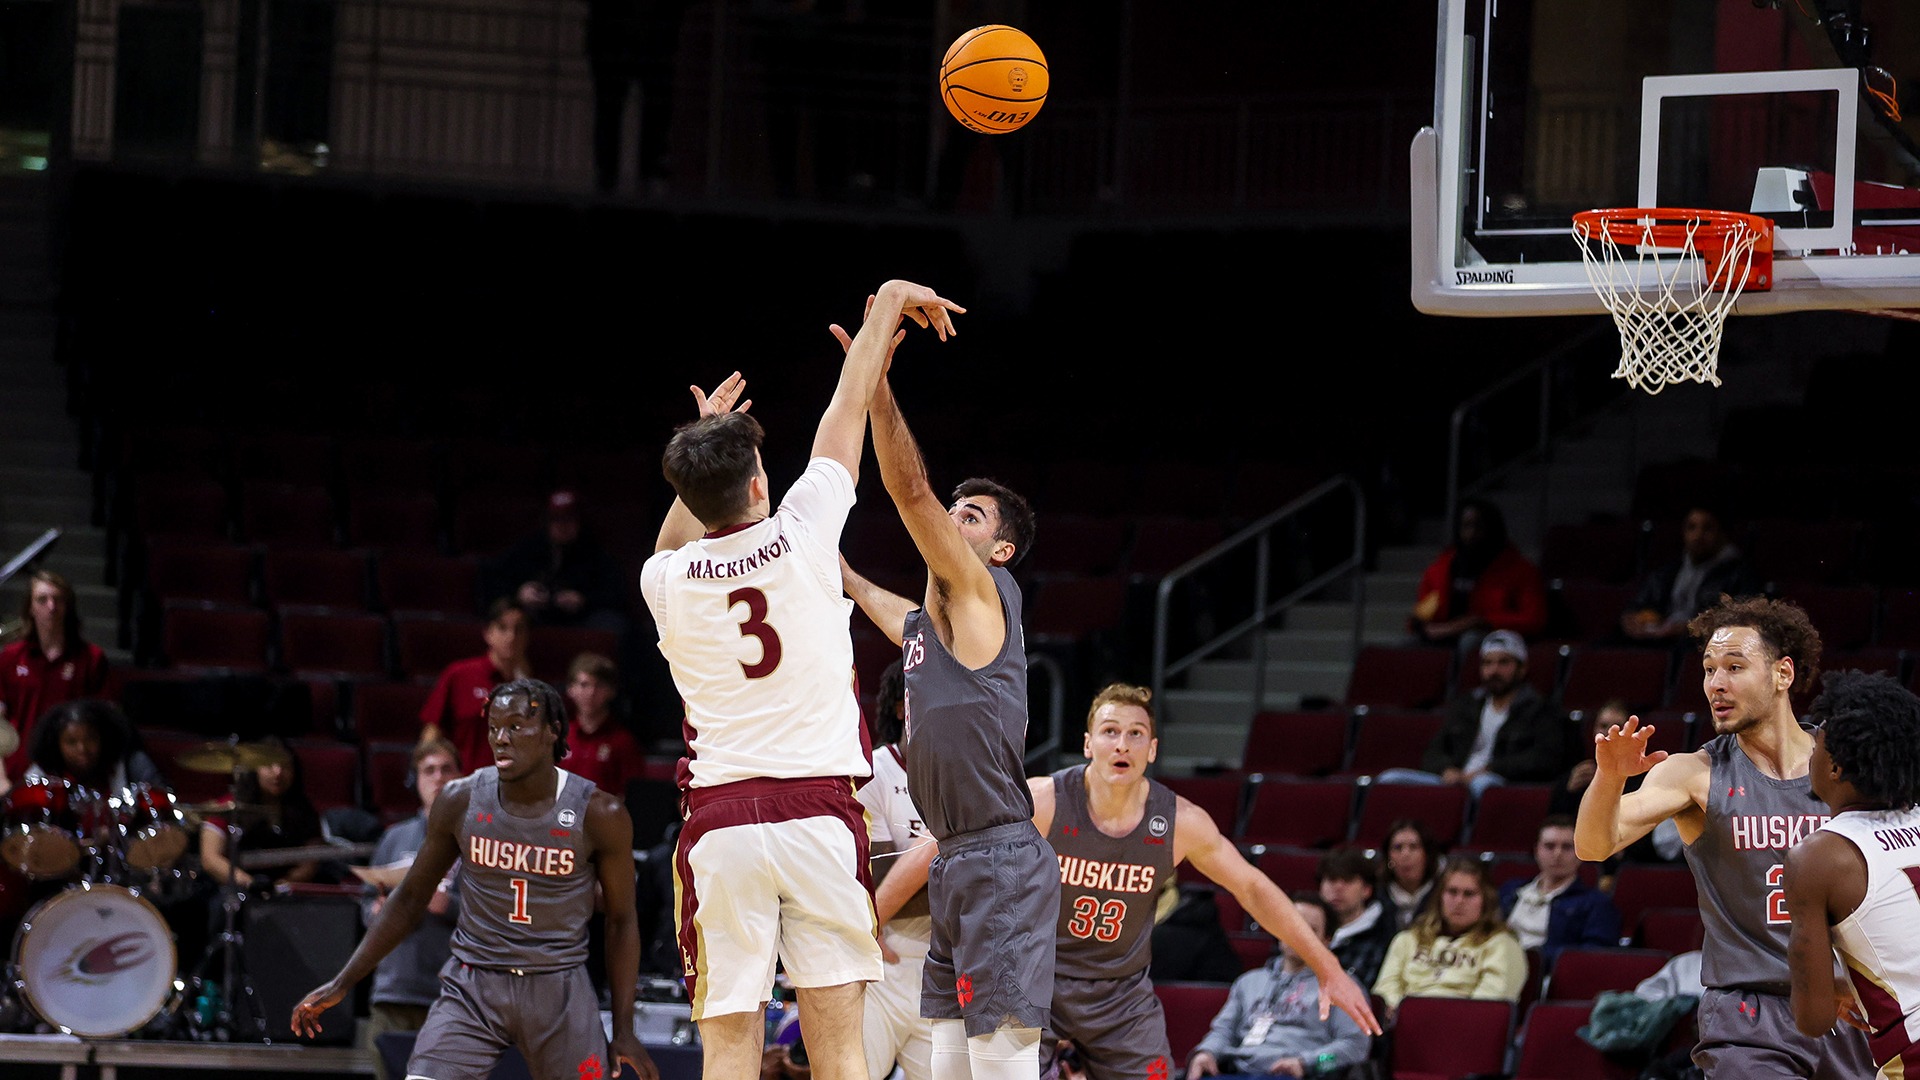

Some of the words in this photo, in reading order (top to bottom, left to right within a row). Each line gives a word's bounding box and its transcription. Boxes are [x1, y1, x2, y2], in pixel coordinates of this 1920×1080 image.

[987, 111, 1030, 123] EVO
[1455, 270, 1514, 285] SPALDING
[687, 530, 792, 579] MACKINNON
[727, 586, 784, 681] 3
[470, 835, 575, 876] HUSKIES
[1057, 854, 1156, 894] HUSKIES
[508, 878, 532, 925] 1
[1068, 895, 1127, 943] 33
